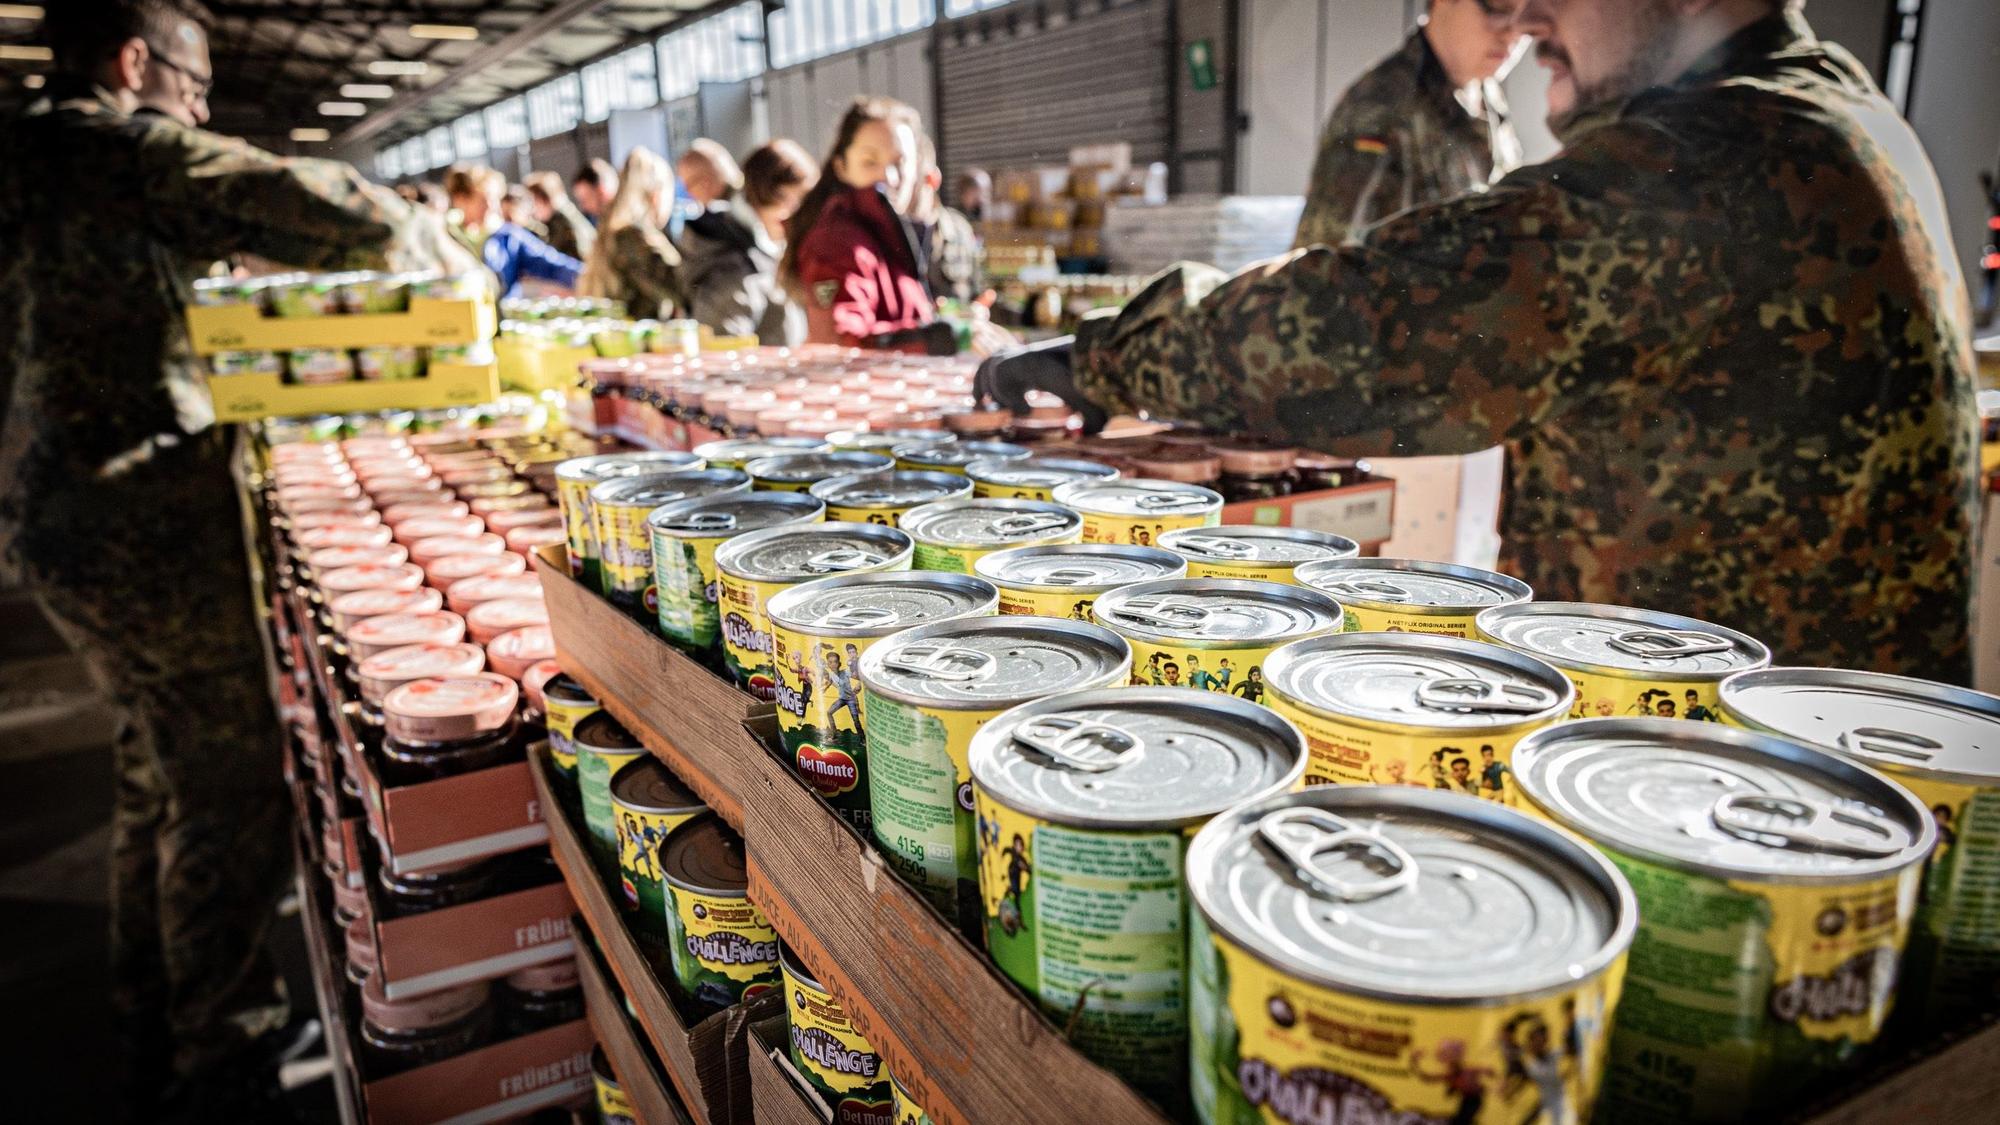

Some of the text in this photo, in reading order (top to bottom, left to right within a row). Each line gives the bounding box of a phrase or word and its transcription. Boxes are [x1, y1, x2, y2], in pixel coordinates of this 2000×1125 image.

[800, 755, 854, 779] Del Monte
[897, 834, 924, 862] 415g
[899, 855, 927, 882] 250g
[687, 936, 777, 963] CHALLENGE
[757, 881, 781, 925] JUICE
[787, 921, 801, 950] AU
[803, 940, 822, 975] JUS
[829, 974, 846, 1000] OP
[848, 996, 871, 1033] SAP
[881, 1035, 897, 1071] IN
[899, 1058, 930, 1113] SAFT
[792, 1026, 875, 1076] CHALLENGE
[842, 1108, 892, 1125] Del Mon
